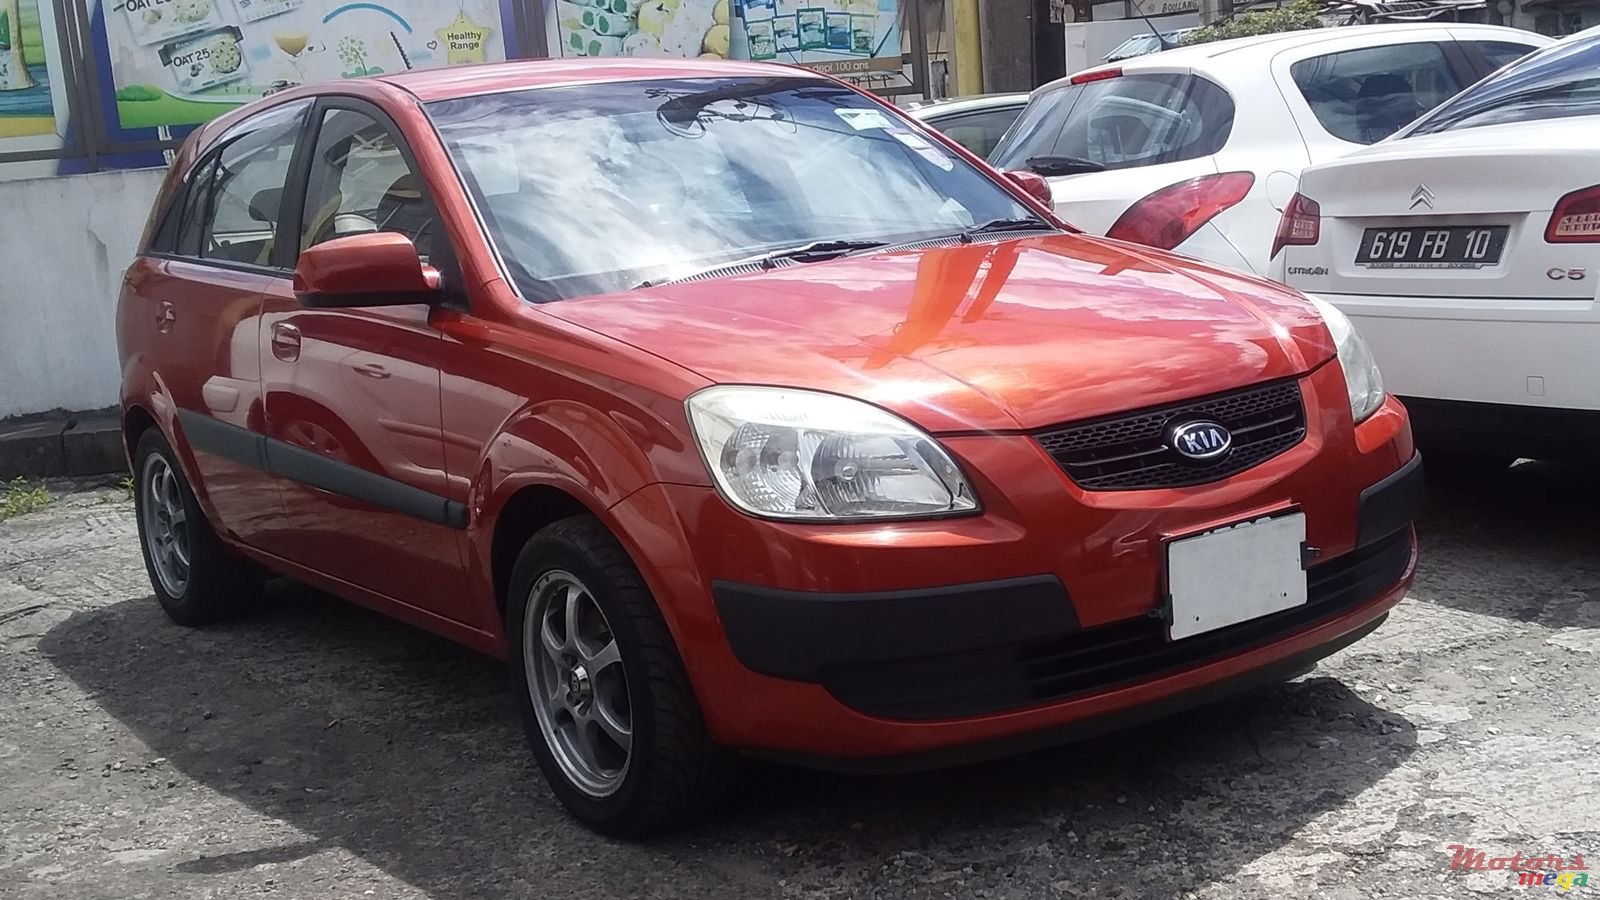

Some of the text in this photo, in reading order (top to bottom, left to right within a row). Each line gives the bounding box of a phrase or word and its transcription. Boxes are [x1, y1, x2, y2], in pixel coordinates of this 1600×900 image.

[447, 31, 482, 41] Healthy
[450, 41, 480, 50] Range
[835, 61, 852, 71] 100
[853, 61, 869, 70] ans
[1369, 230, 1492, 259] 619 FB 10
[1546, 267, 1586, 280] C5
[1182, 428, 1225, 453] KIA
